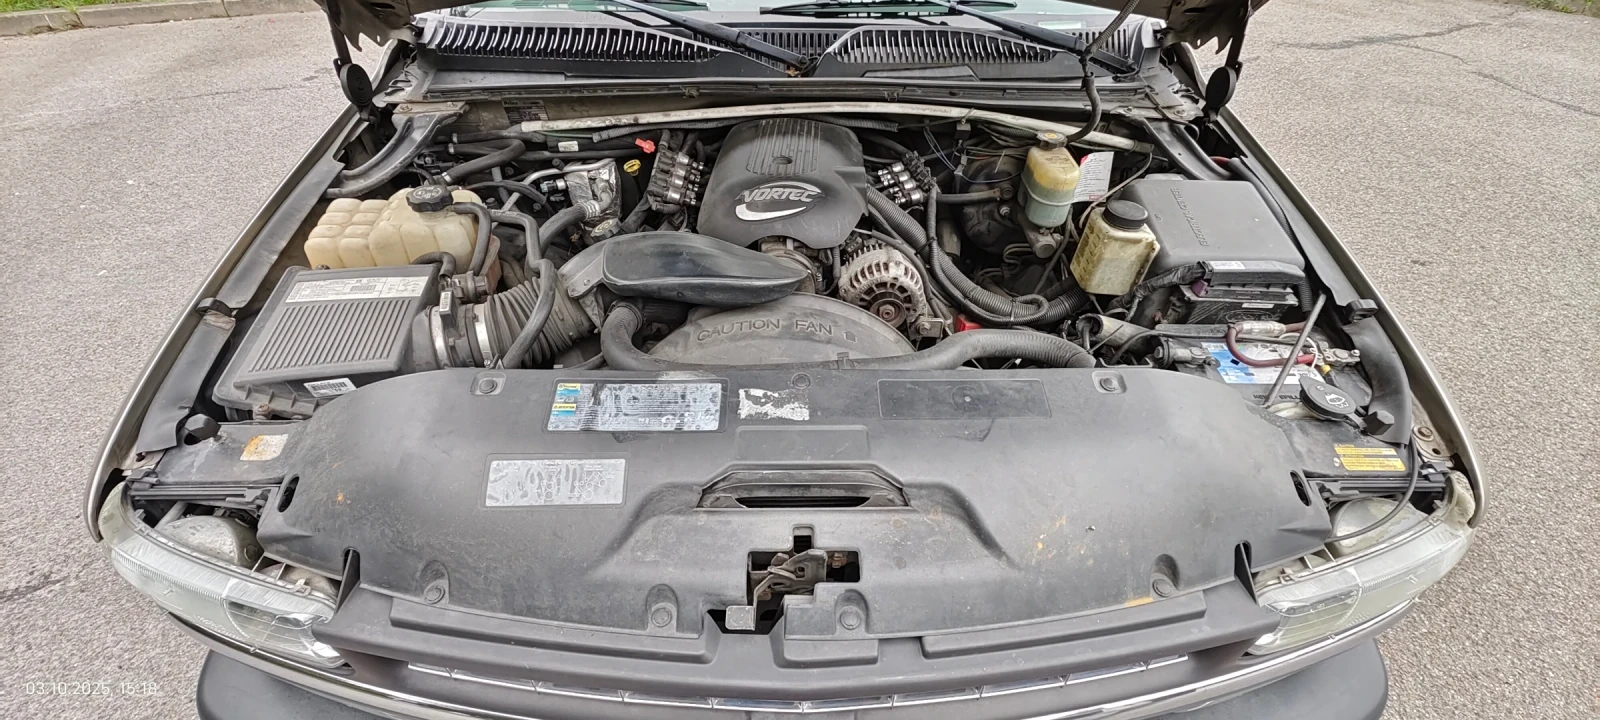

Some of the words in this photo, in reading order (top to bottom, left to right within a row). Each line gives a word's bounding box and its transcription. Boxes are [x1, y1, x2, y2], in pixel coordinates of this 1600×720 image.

[742, 187, 819, 203] VORTEC
[697, 318, 780, 342] CAUTION
[795, 319, 833, 336] FAN
